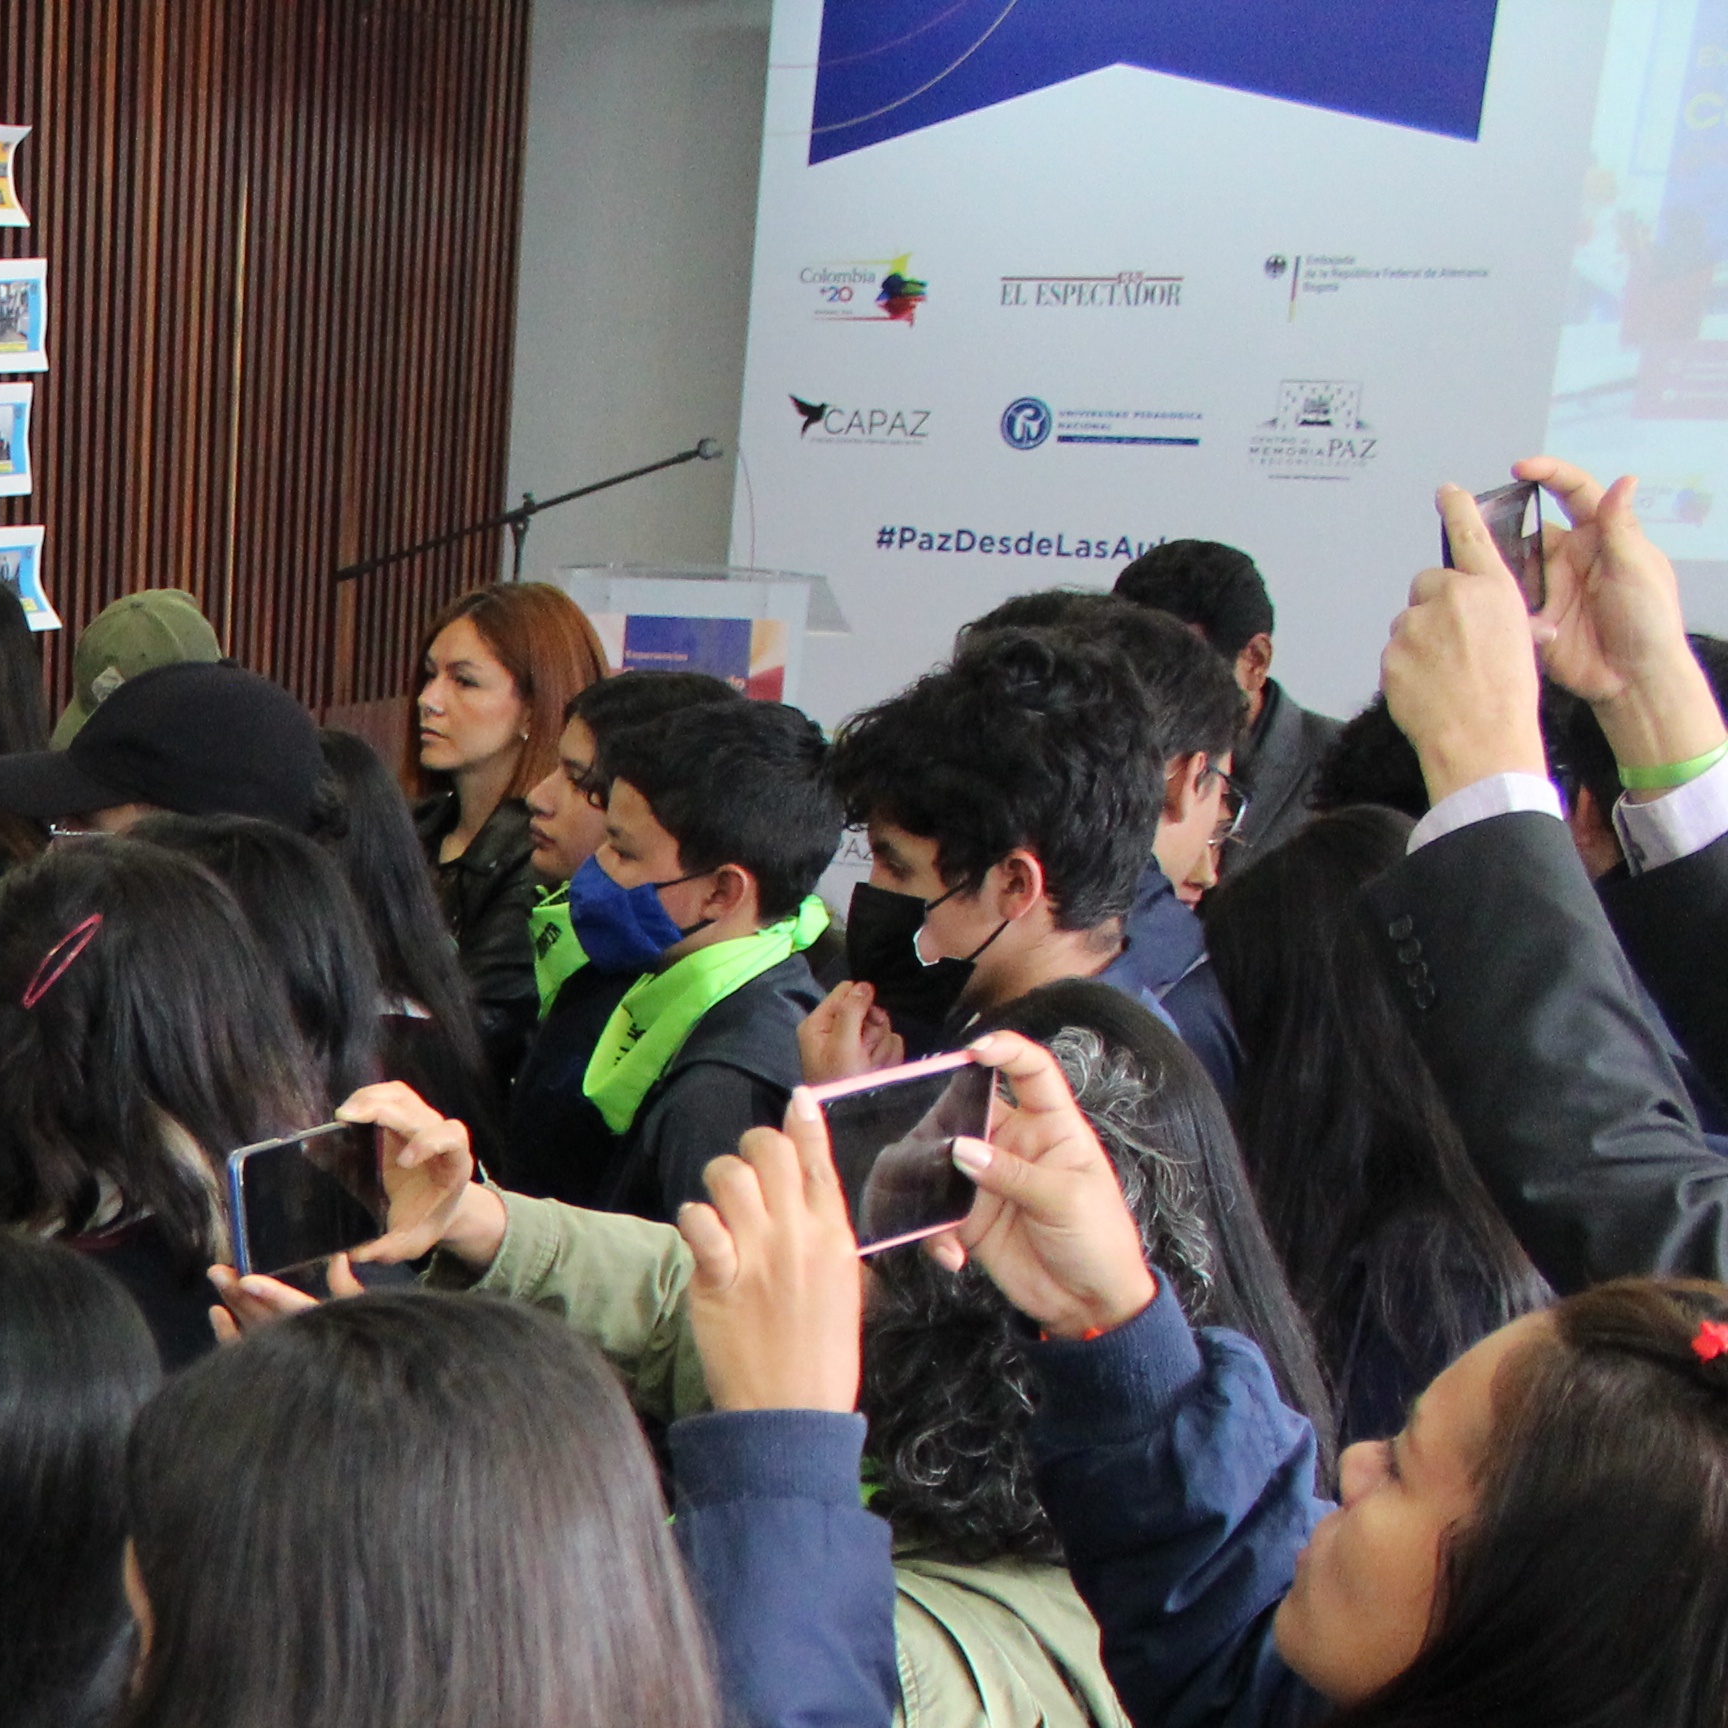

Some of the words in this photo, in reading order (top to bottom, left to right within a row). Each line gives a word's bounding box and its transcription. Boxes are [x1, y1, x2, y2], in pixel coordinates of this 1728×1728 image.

[800, 267, 876, 283] Colombia
[1000, 282, 1027, 306] EL
[1035, 282, 1182, 307] ESPECTADOR
[824, 407, 931, 437] CAPAZ
[1327, 438, 1378, 459] PAZ
